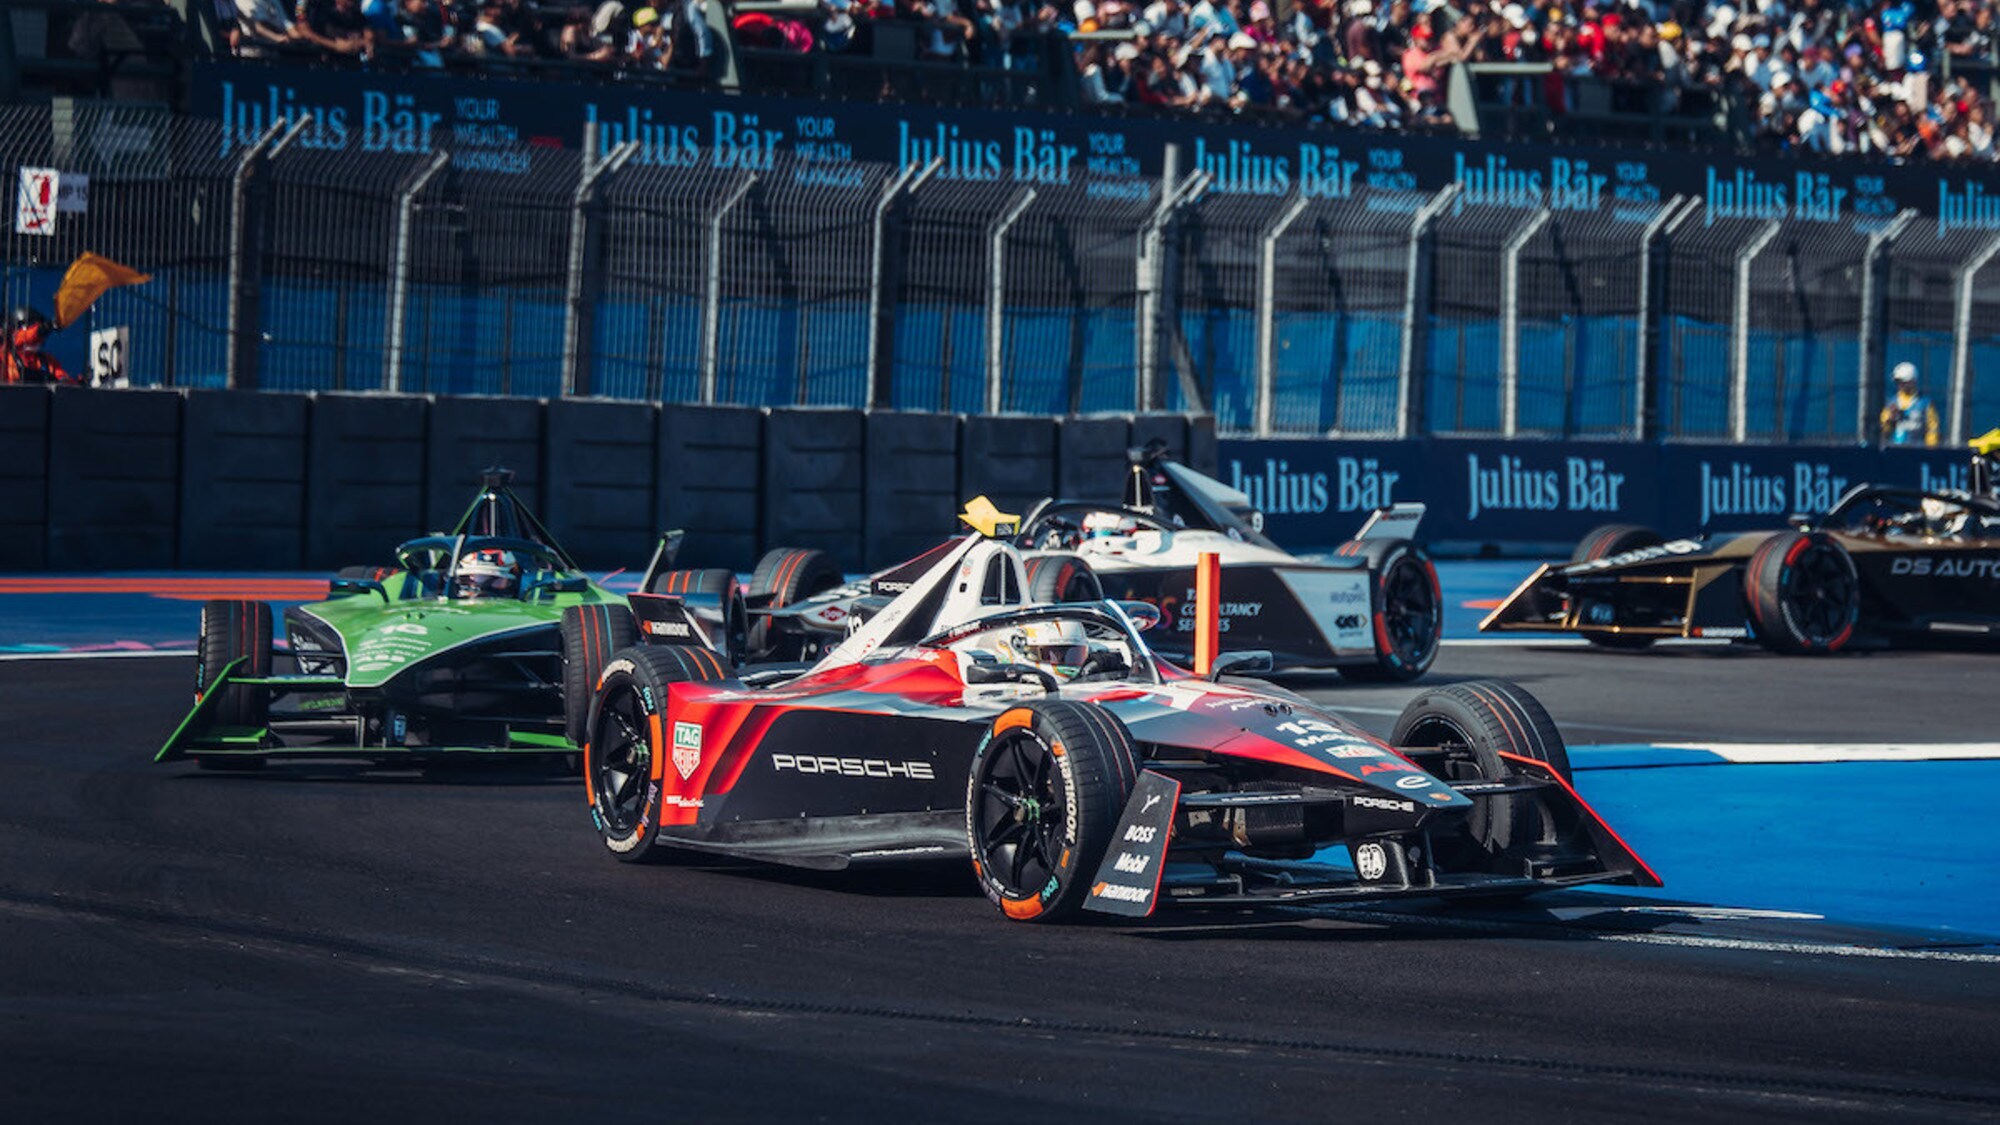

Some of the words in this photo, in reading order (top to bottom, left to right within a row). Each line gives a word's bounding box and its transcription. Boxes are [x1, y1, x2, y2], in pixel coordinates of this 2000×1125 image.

[219, 81, 347, 159] Julius
[363, 90, 441, 153] Bär
[454, 97, 500, 120] YOUR
[796, 116, 836, 137] YOUR
[713, 110, 784, 170] Bär
[795, 141, 852, 161] WEALTH
[899, 121, 1001, 182] Julius
[1013, 126, 1078, 184] Bär
[1088, 132, 1125, 153] YOUR
[1195, 137, 1290, 200] Julius
[1299, 142, 1360, 198] Bär
[1452, 152, 1542, 217] Julius
[1552, 157, 1607, 211] Bär
[1704, 165, 1787, 228] Julius
[1796, 170, 1848, 224] Bär
[1231, 458, 1328, 514] Julius
[1338, 457, 1399, 512] Bär
[1467, 453, 1560, 520] Julius
[1567, 456, 1625, 512] Bär
[1701, 460, 1786, 527] Julius
[1794, 462, 1847, 515] Bär
[1891, 558, 1932, 576] DS
[676, 726, 700, 748] TAG
[772, 754, 935, 780] PORSCHE
[1353, 796, 1414, 813] PORSCHE
[1124, 824, 1157, 843] BOSS
[1113, 852, 1151, 874] Mobil
